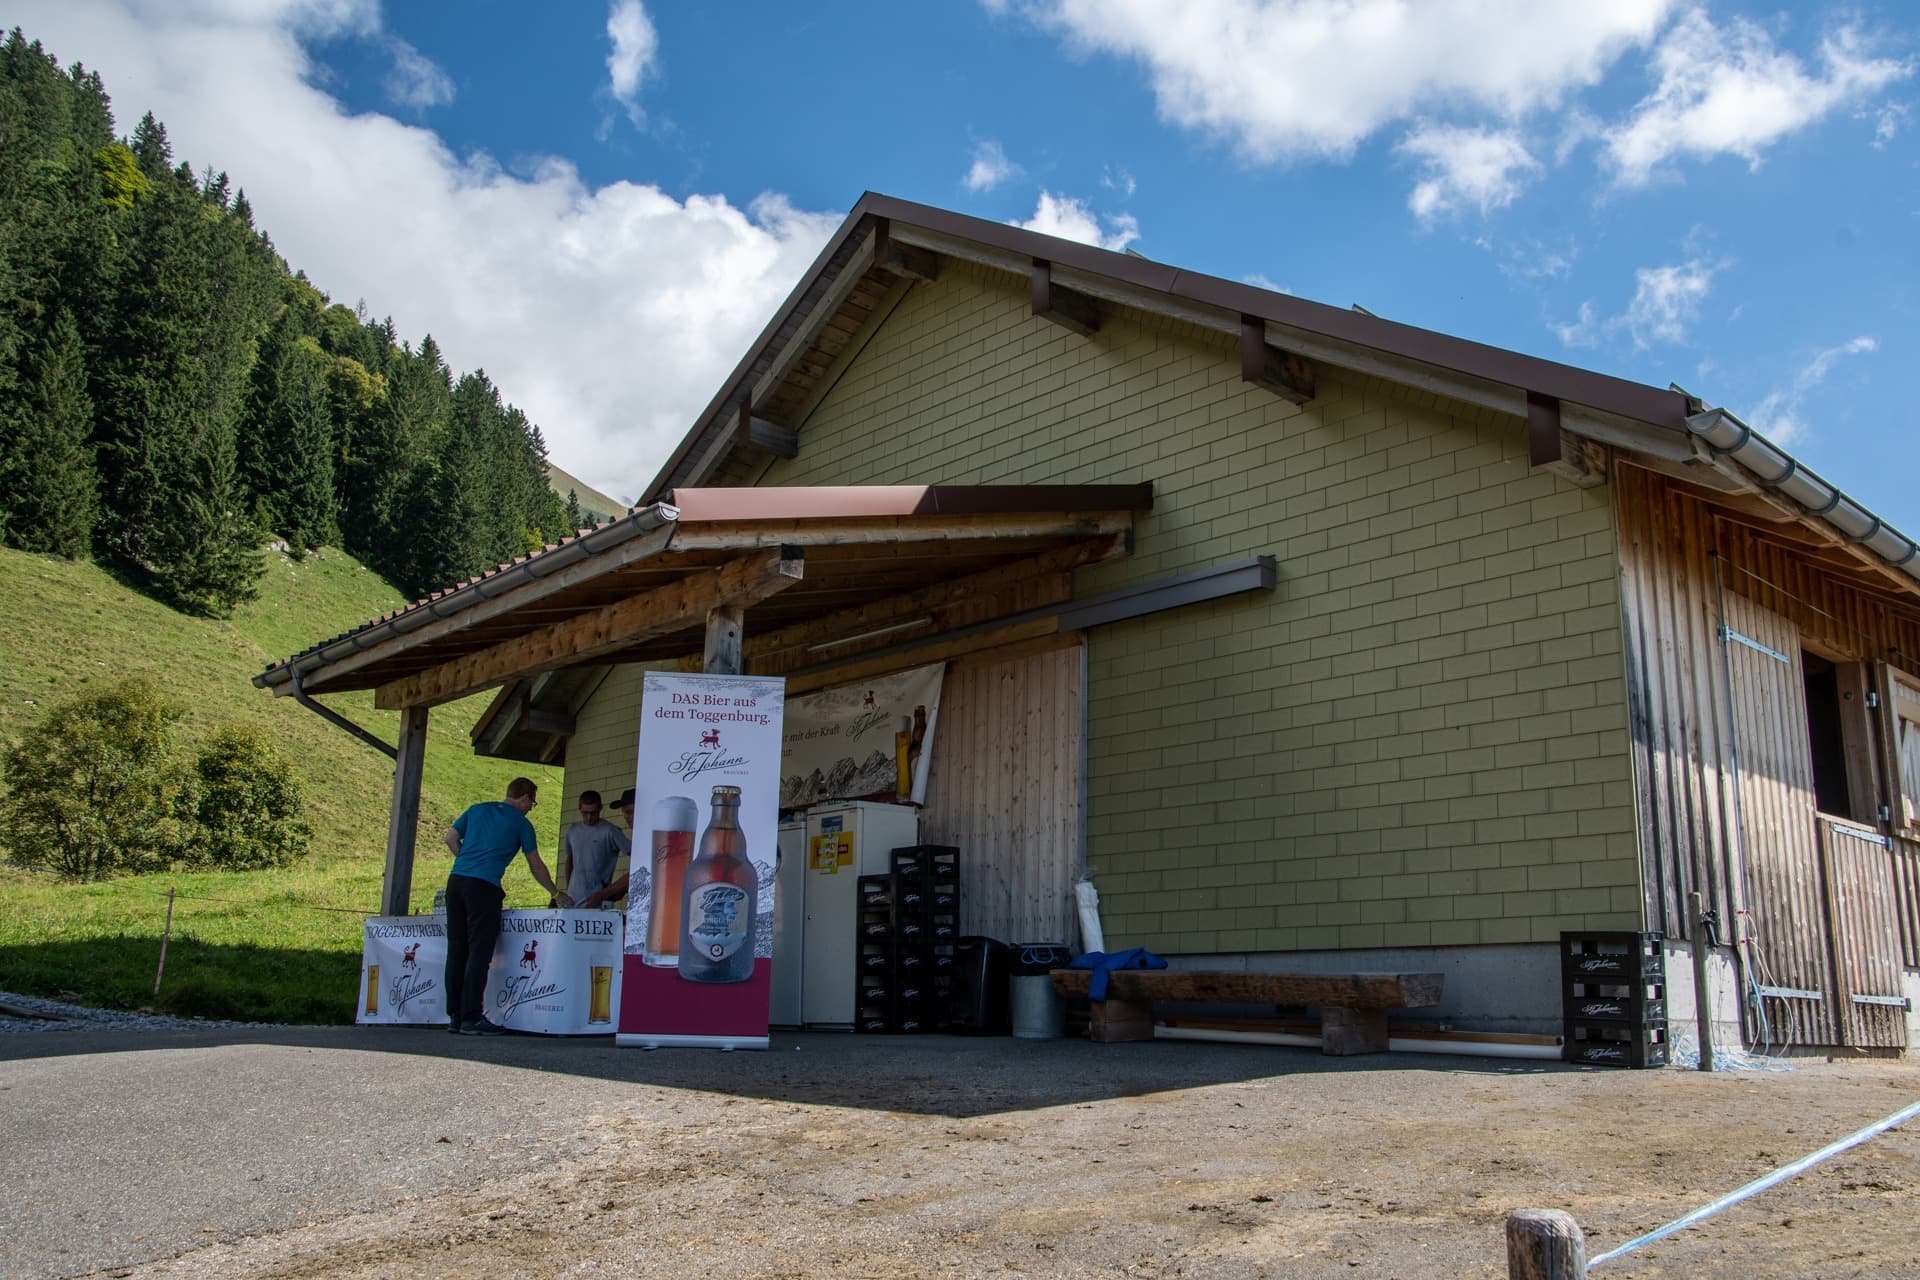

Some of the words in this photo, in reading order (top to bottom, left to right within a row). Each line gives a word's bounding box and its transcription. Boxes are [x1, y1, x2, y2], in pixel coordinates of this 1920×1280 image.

[671, 693, 700, 704] DAS
[703, 694, 730, 706] Bier
[733, 697, 757, 707] aus
[655, 706, 684, 719] dem
[687, 708, 771, 725] Toggenburg.
[805, 727, 818, 740] der
[820, 723, 840, 737] Kraft
[682, 748, 751, 782] Johann
[502, 918, 567, 934] ENBURGER
[574, 920, 614, 936] BIER
